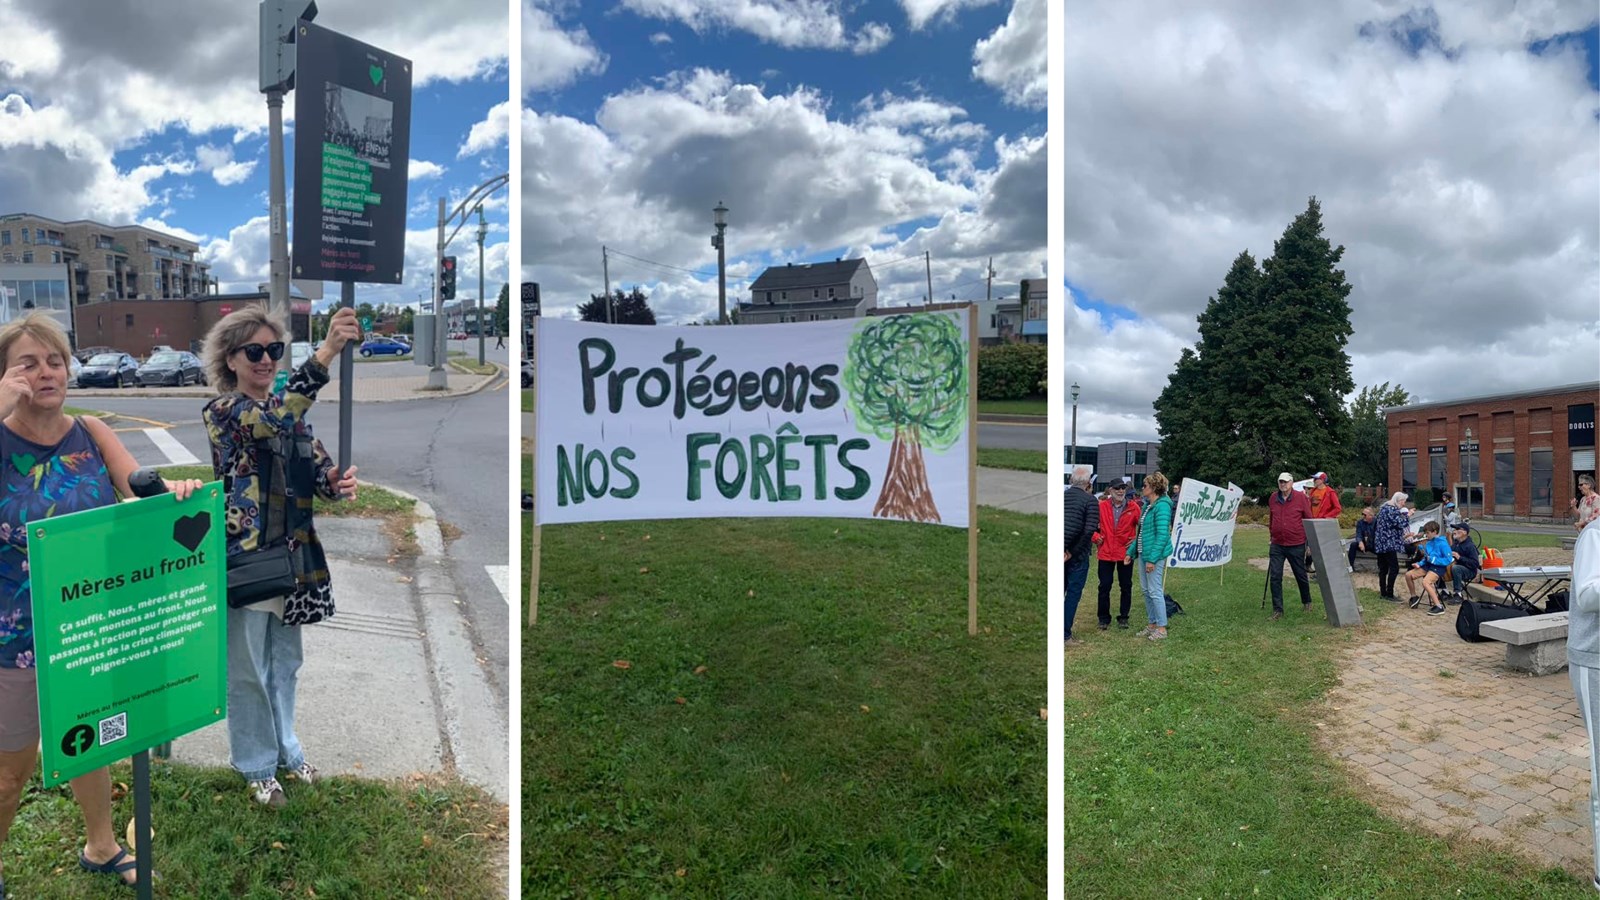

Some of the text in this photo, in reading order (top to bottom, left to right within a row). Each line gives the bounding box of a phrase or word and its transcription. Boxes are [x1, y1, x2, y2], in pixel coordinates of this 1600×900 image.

[578, 337, 840, 419] Protégeons
[557, 421, 871, 507] NOS FORÊTS
[61, 551, 205, 603] Mères au front
[49, 603, 217, 664] passons à l'action pour protéger nos
[59, 582, 208, 634] Ça suffit. Nous, mères et grand-
[62, 595, 207, 645] mères, montons au front. Nous
[66, 620, 205, 670] enfants de la crise climatique.
[90, 637, 185, 676] Joignez-vous à nous!
[77, 673, 199, 720] Mères au front Vaudreuil-Soulanges
